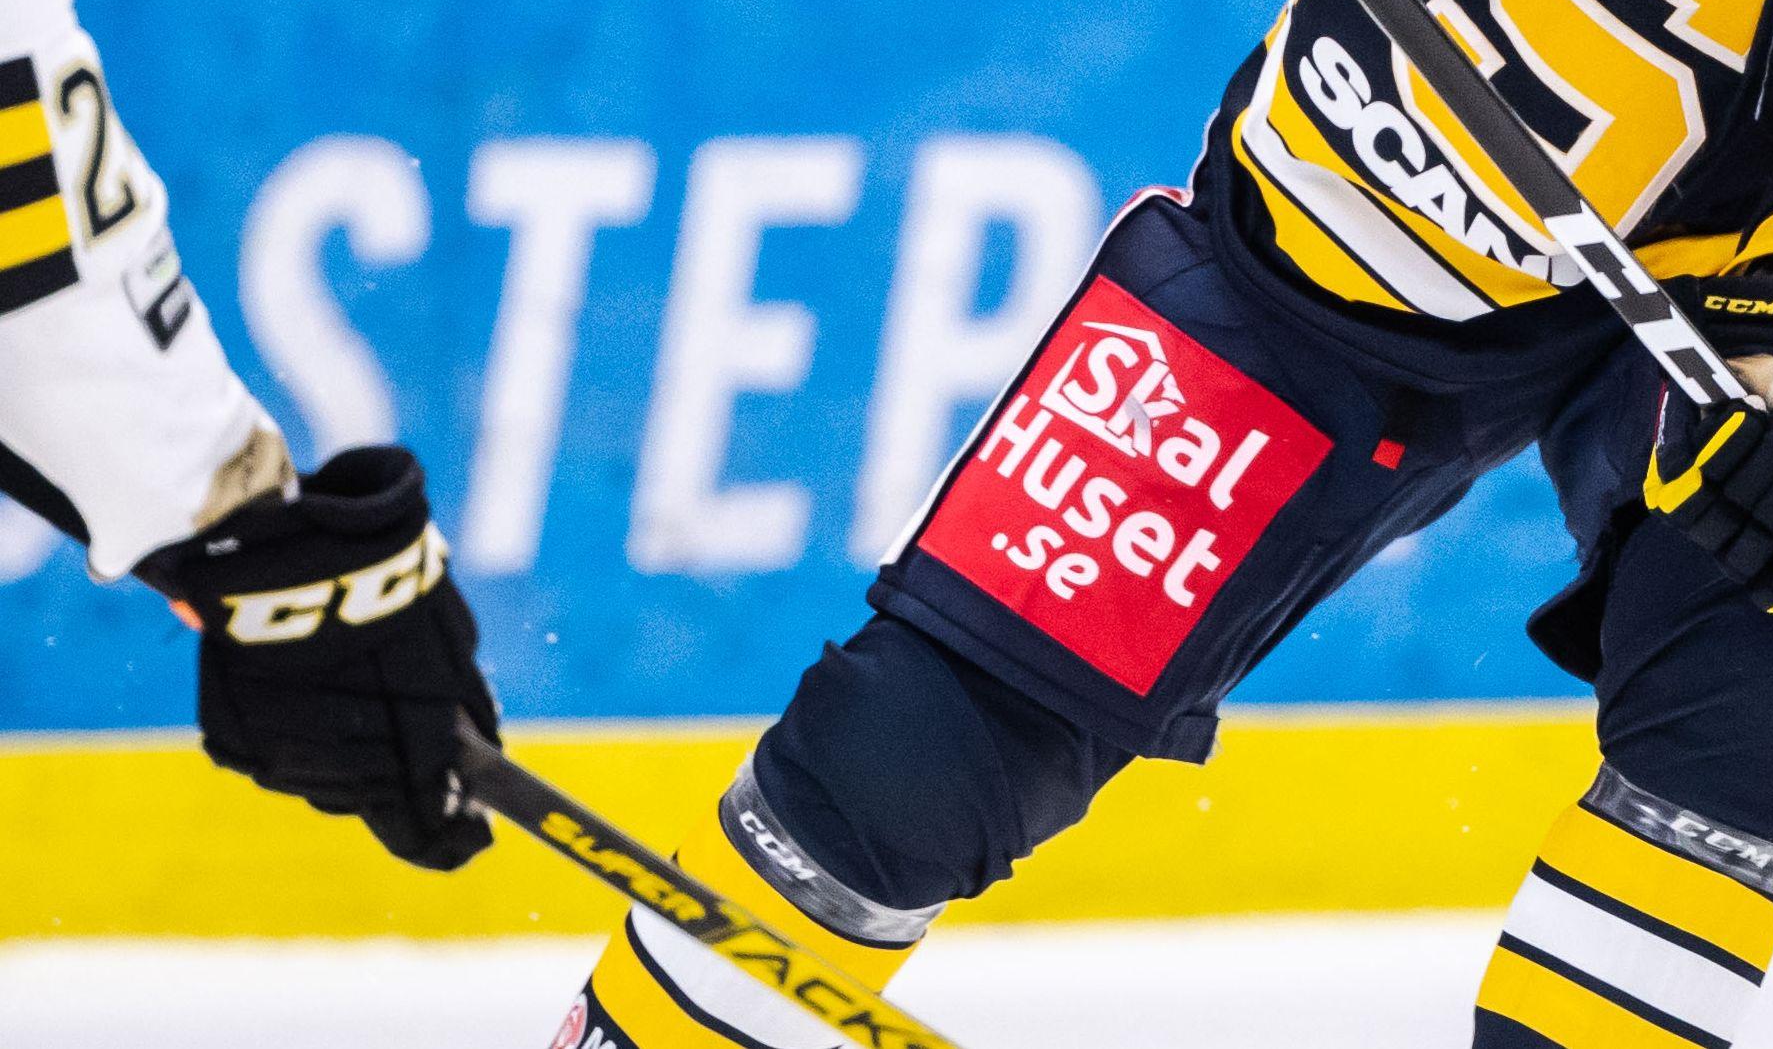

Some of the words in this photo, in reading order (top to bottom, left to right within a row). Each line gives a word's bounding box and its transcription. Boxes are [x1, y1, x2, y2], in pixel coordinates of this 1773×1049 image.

[1299, 36, 1588, 287] SCAN
[239, 133, 1106, 574] STEP
[1543, 199, 1750, 405] CC
[978, 394, 1222, 609] Huset
[991, 524, 1100, 601] .se
[540, 810, 707, 923] SUPER
[740, 809, 817, 882] CCM
[1670, 813, 1773, 869] CCM
[698, 901, 932, 1049] TACK
